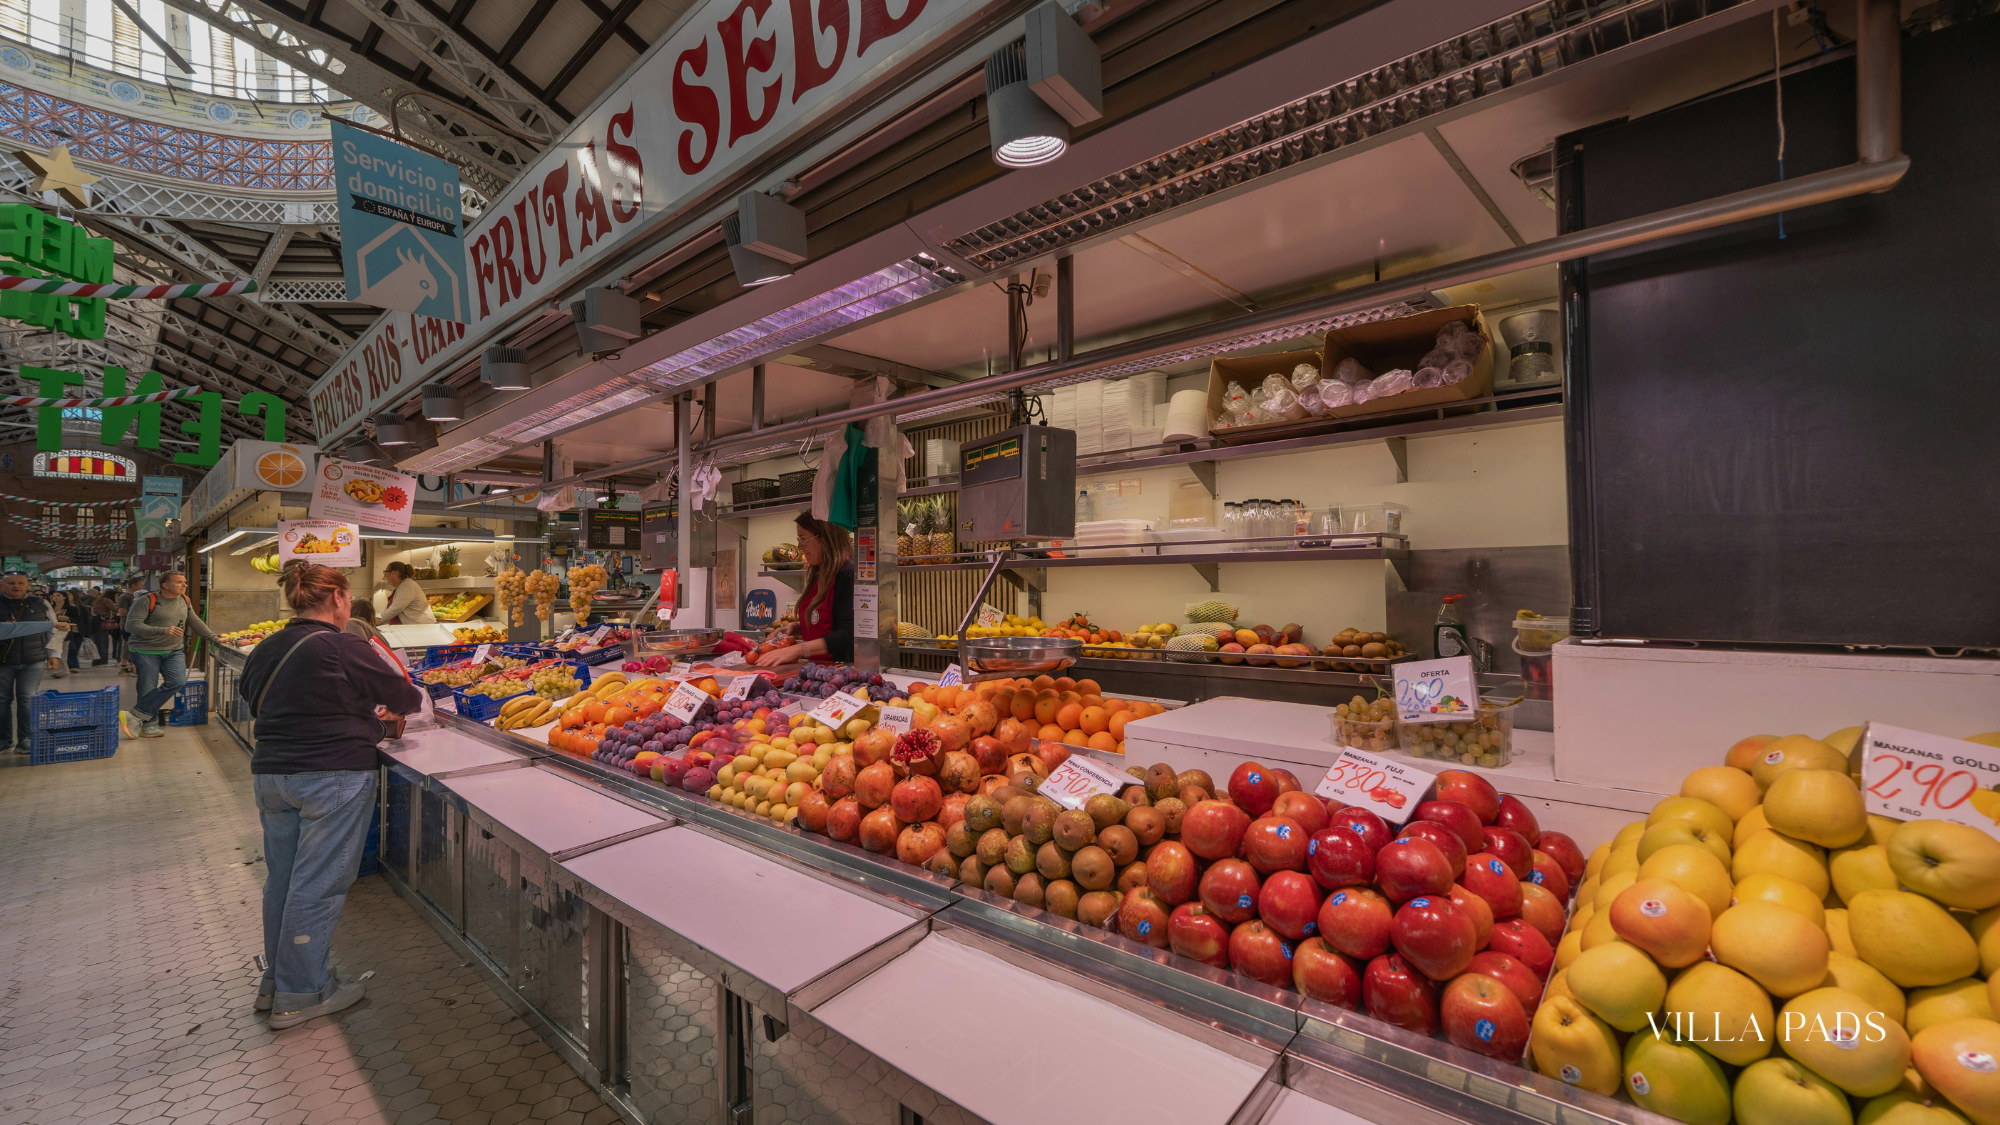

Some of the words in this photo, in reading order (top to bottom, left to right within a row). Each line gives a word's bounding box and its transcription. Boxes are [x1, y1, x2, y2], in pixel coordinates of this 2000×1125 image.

[342, 140, 437, 192] Servicio
[443, 182, 454, 199] a
[348, 171, 454, 222] domicilio
[377, 204, 409, 222] ESPAÑA
[409, 213, 415, 224] Y
[416, 217, 447, 233] EUROPA
[470, 103, 644, 322] FRUTAS
[313, 358, 363, 439] FRUTAS
[320, 489, 338, 497] take
[320, 494, 341, 502] away
[387, 493, 402, 504] 3€
[1420, 670, 1450, 678] OFERTA
[884, 714, 909, 723] GRANADAS
[1344, 751, 1378, 766] MANZANAS
[1385, 764, 1404, 775] FUJI
[1874, 741, 1943, 760] MANZANAS
[1953, 756, 2000, 772] GOLD
[1067, 759, 1080, 769] PERAS
[1079, 766, 1114, 787] CONFERENCIA
[1899, 806, 1922, 817] KILO
